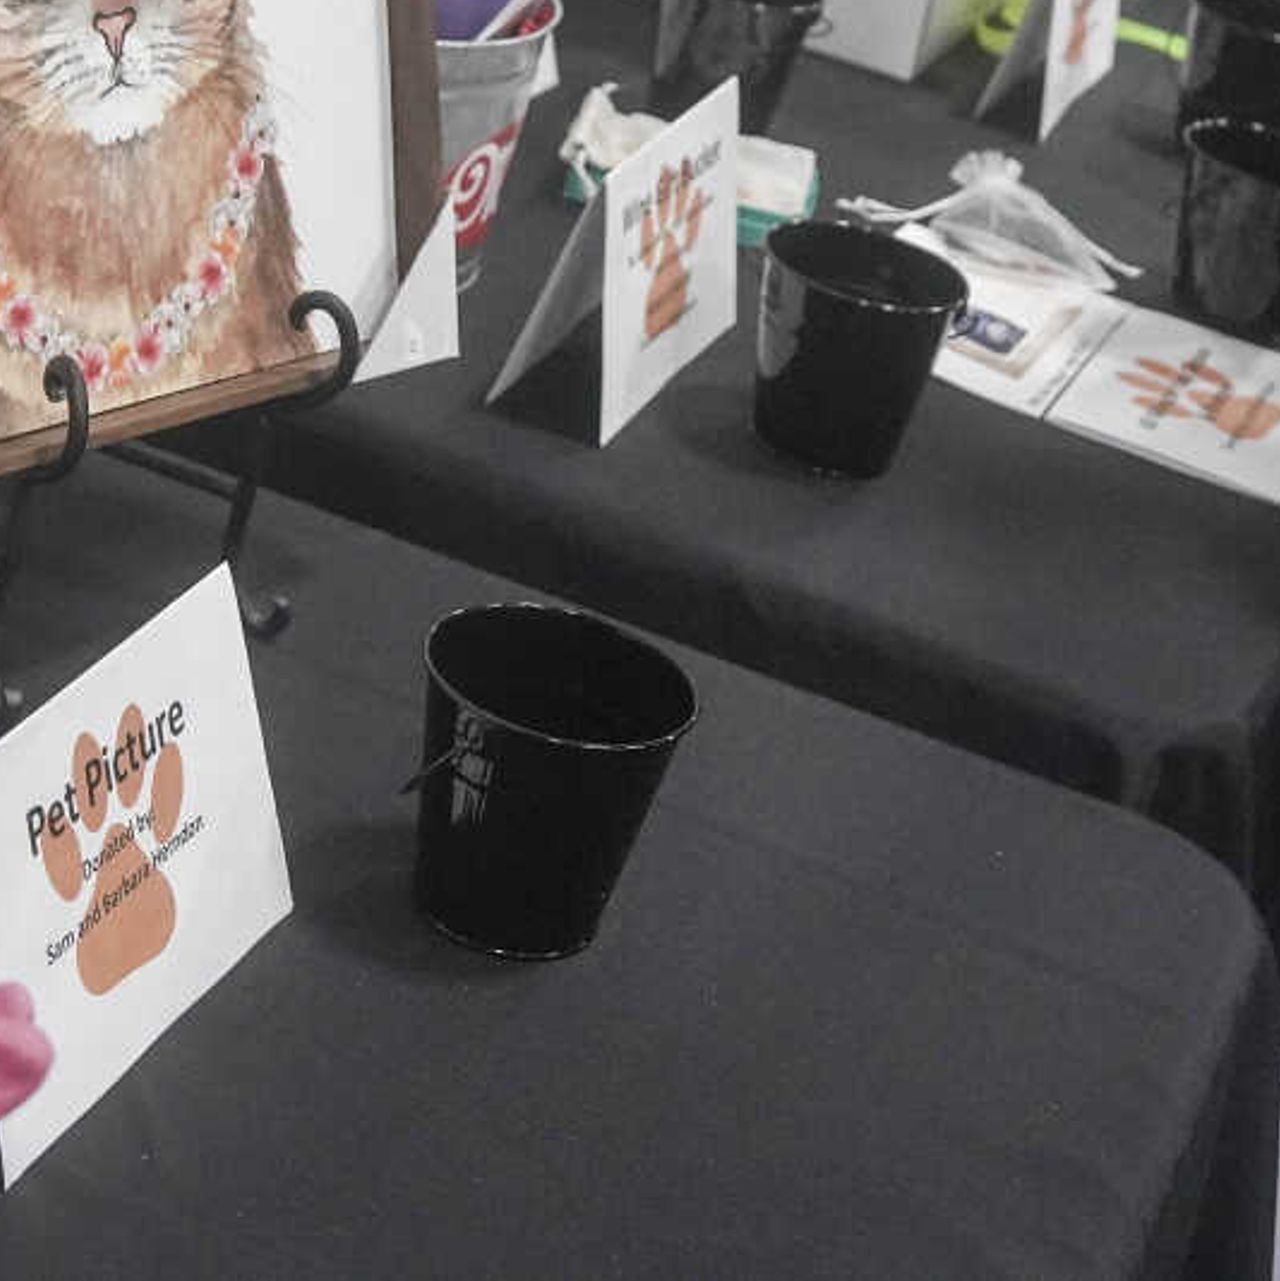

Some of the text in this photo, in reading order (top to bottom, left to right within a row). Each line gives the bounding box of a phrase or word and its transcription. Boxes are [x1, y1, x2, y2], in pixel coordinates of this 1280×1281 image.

[26, 700, 185, 857] Pet Picture
[83, 819, 136, 881] Donated
[47, 931, 75, 965] Sam
[78, 902, 102, 938] and
[102, 863, 151, 915] Barbara
